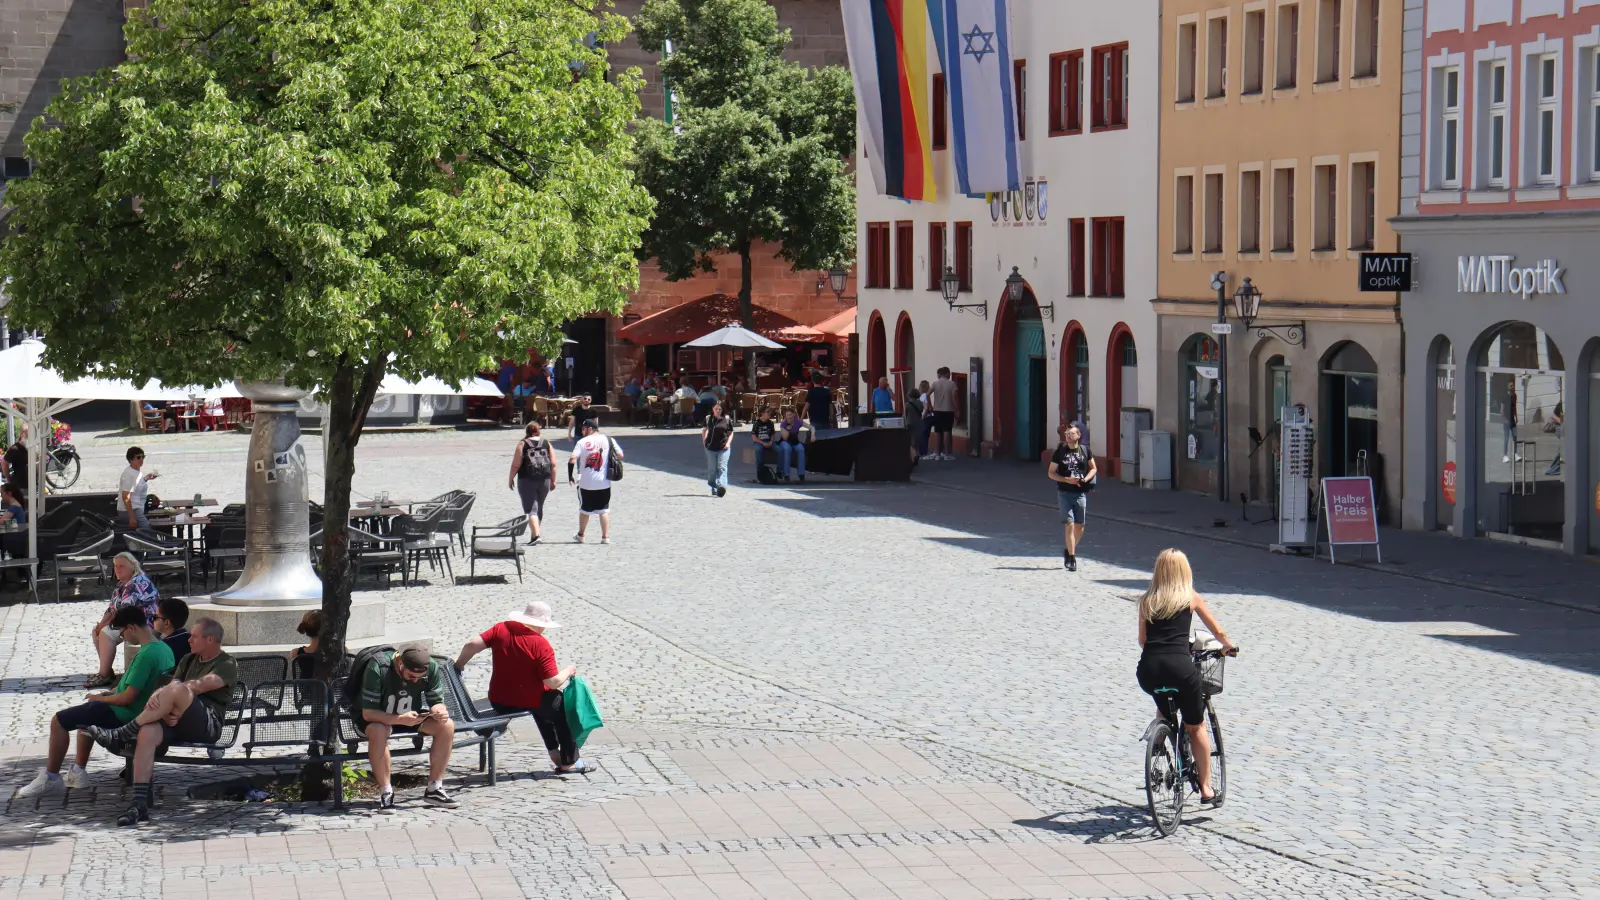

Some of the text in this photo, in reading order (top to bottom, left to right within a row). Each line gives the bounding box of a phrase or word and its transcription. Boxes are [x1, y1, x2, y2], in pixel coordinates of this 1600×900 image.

[1365, 257, 1408, 273] MATT
[1369, 275, 1401, 288] optik
[1333, 494, 1366, 504] Halber
[1334, 504, 1368, 516] Preis
